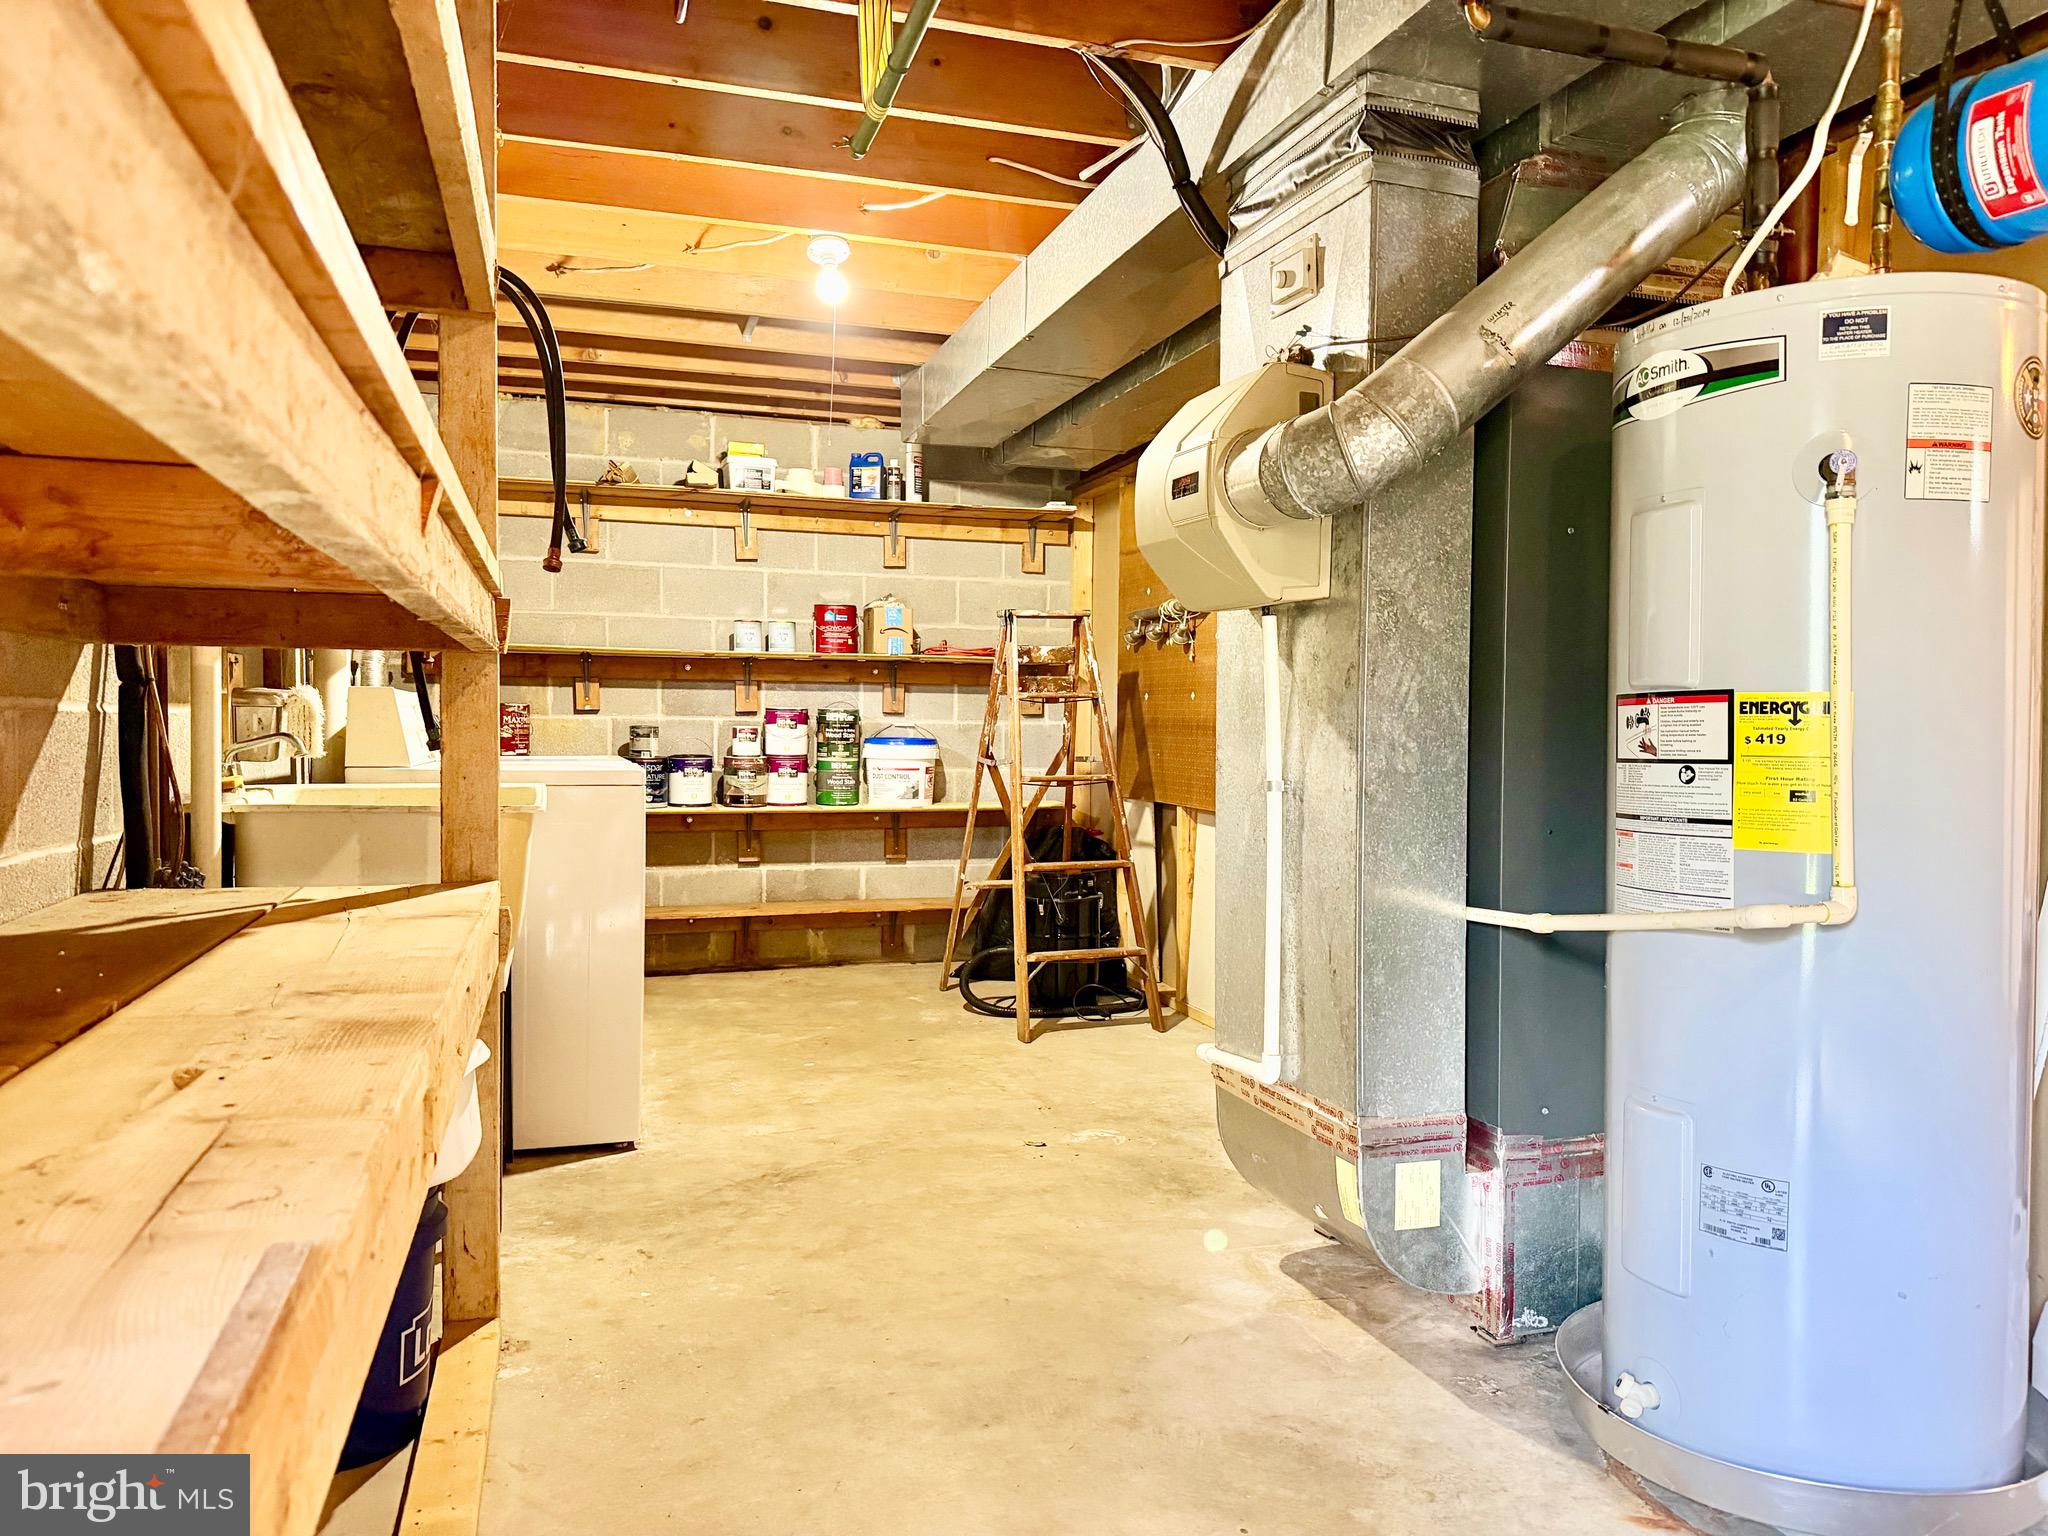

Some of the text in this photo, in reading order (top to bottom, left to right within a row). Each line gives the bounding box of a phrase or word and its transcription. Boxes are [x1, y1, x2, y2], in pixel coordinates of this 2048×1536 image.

[1995, 110, 2018, 195] Expansion Tank
[1487, 301, 1517, 322] WINTER
[1755, 733, 1786, 745] 419
